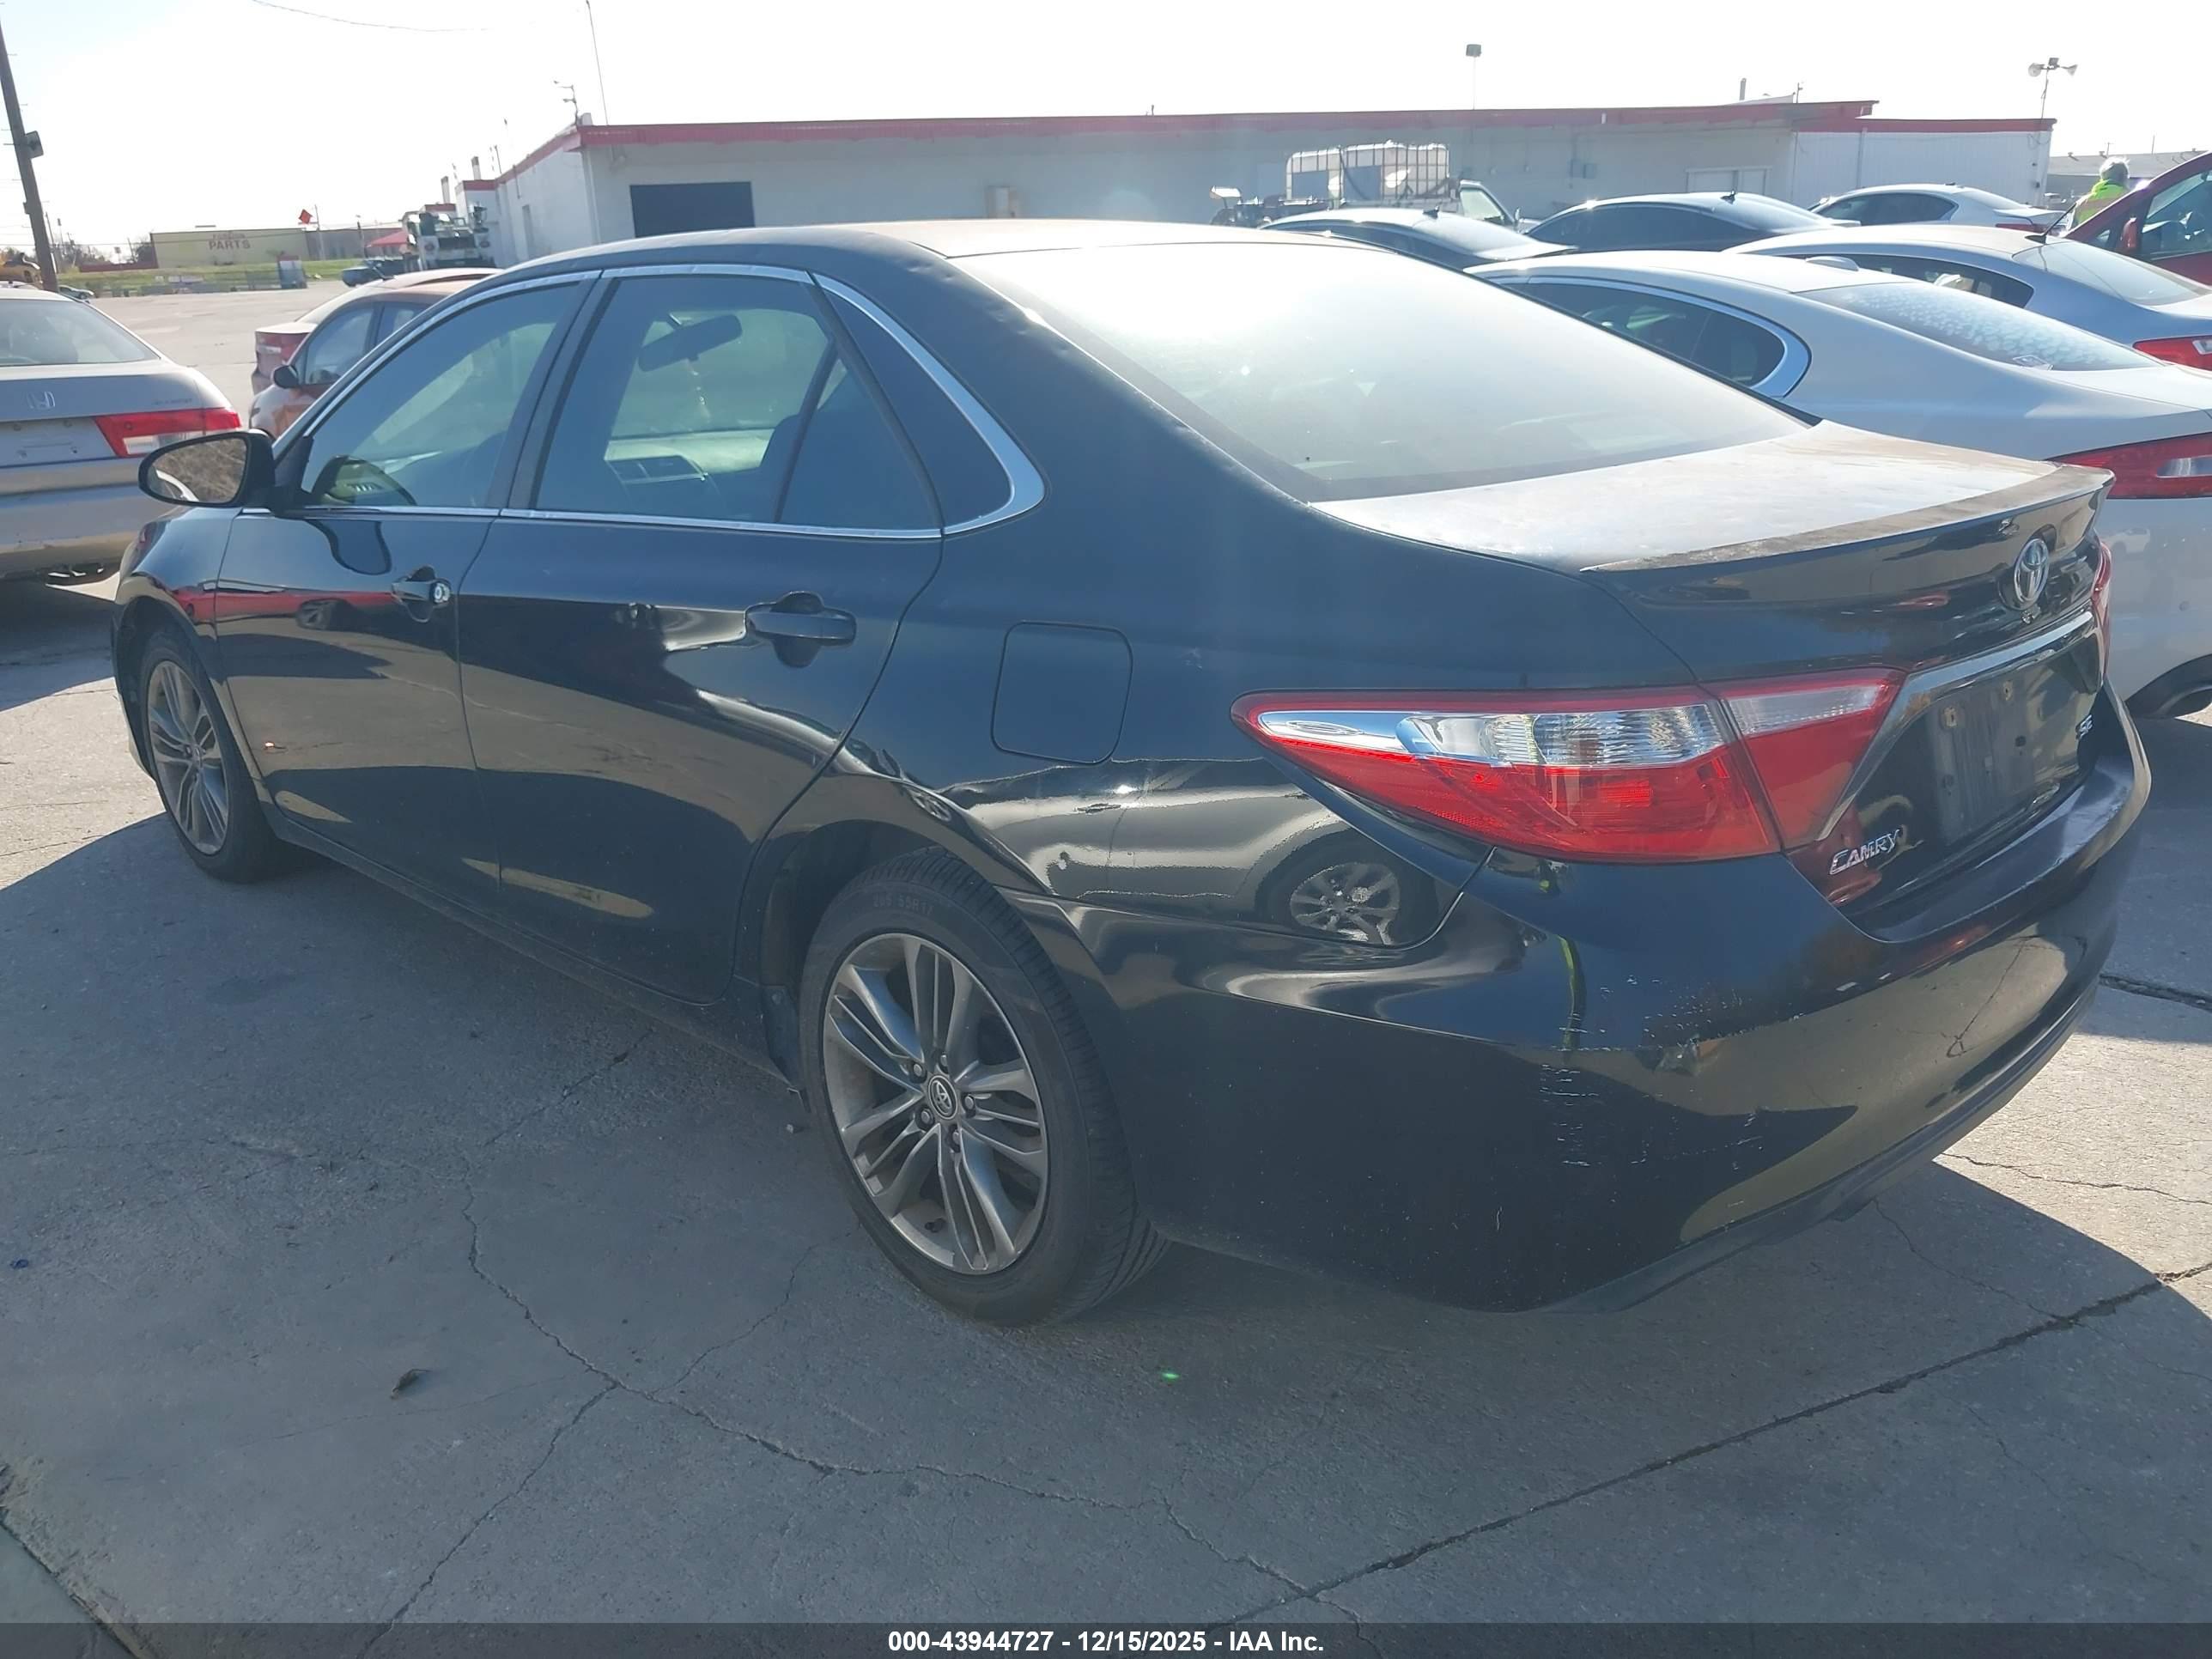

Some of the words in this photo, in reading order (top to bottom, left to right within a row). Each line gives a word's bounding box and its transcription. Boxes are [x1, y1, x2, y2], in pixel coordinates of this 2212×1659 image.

[209, 240, 251, 250] PARTS
[2078, 714, 2093, 738] SE
[1829, 829, 1900, 875] CAMRY
